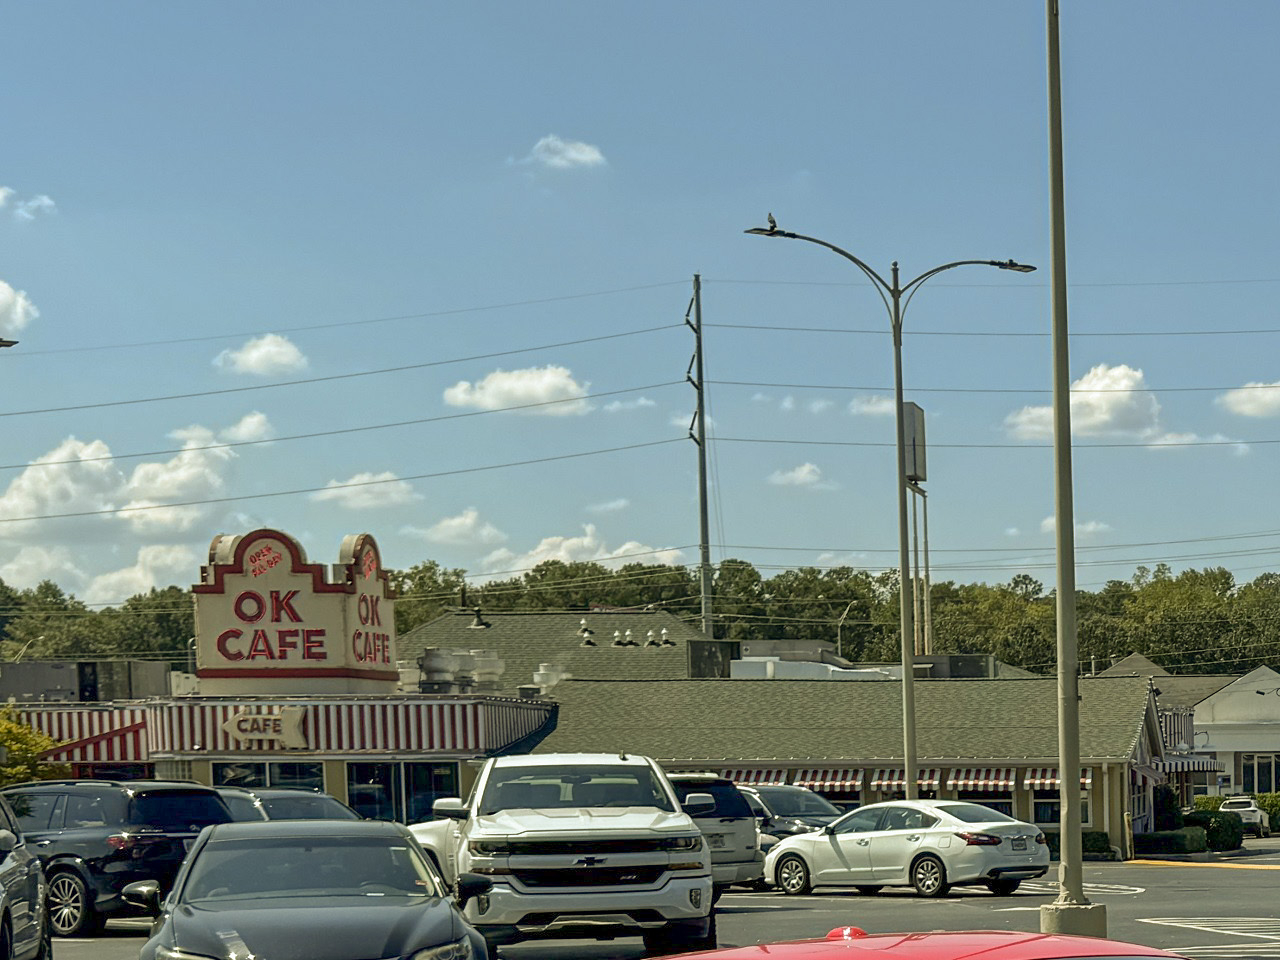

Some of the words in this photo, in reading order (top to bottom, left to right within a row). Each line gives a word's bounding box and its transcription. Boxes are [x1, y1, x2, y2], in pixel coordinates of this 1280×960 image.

[234, 590, 303, 624] OK
[358, 592, 380, 626] OK
[216, 628, 327, 661] CAFE
[352, 628, 390, 664] CAFE
[237, 718, 282, 734] CAFE
